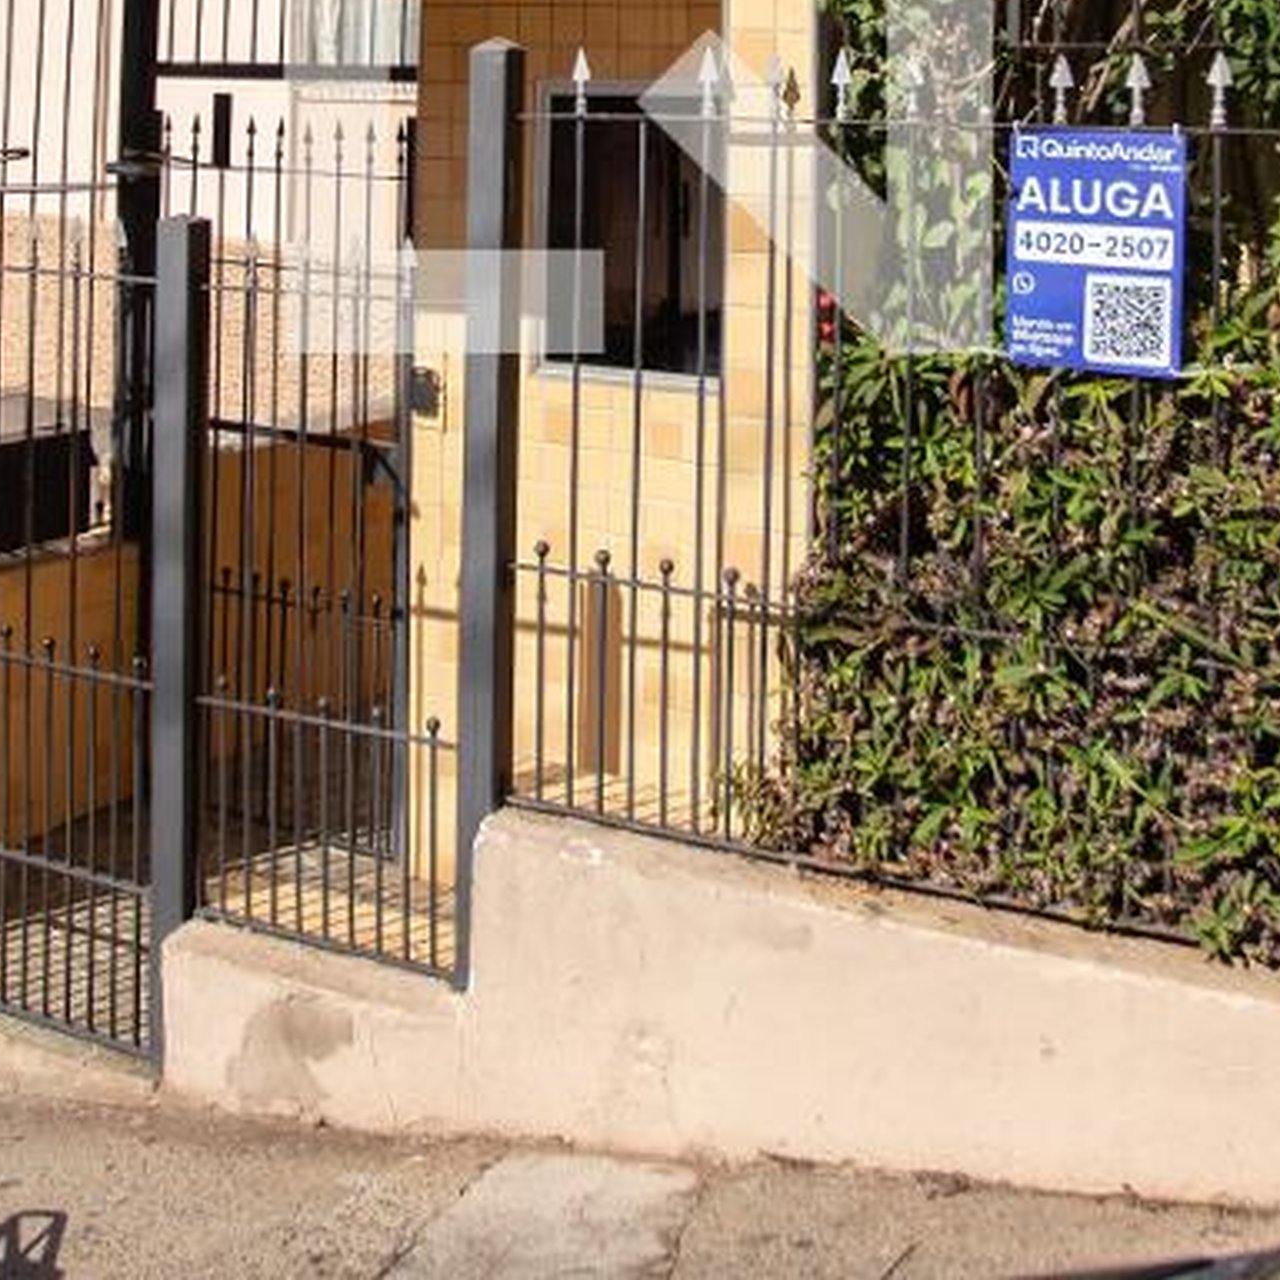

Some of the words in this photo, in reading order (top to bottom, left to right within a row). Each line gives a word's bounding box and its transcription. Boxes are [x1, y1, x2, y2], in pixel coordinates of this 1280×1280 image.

[1041, 138, 1177, 163] QuintoAndar
[1016, 175, 1175, 219] ALUGA
[1019, 230, 1170, 261] 4020-2507
